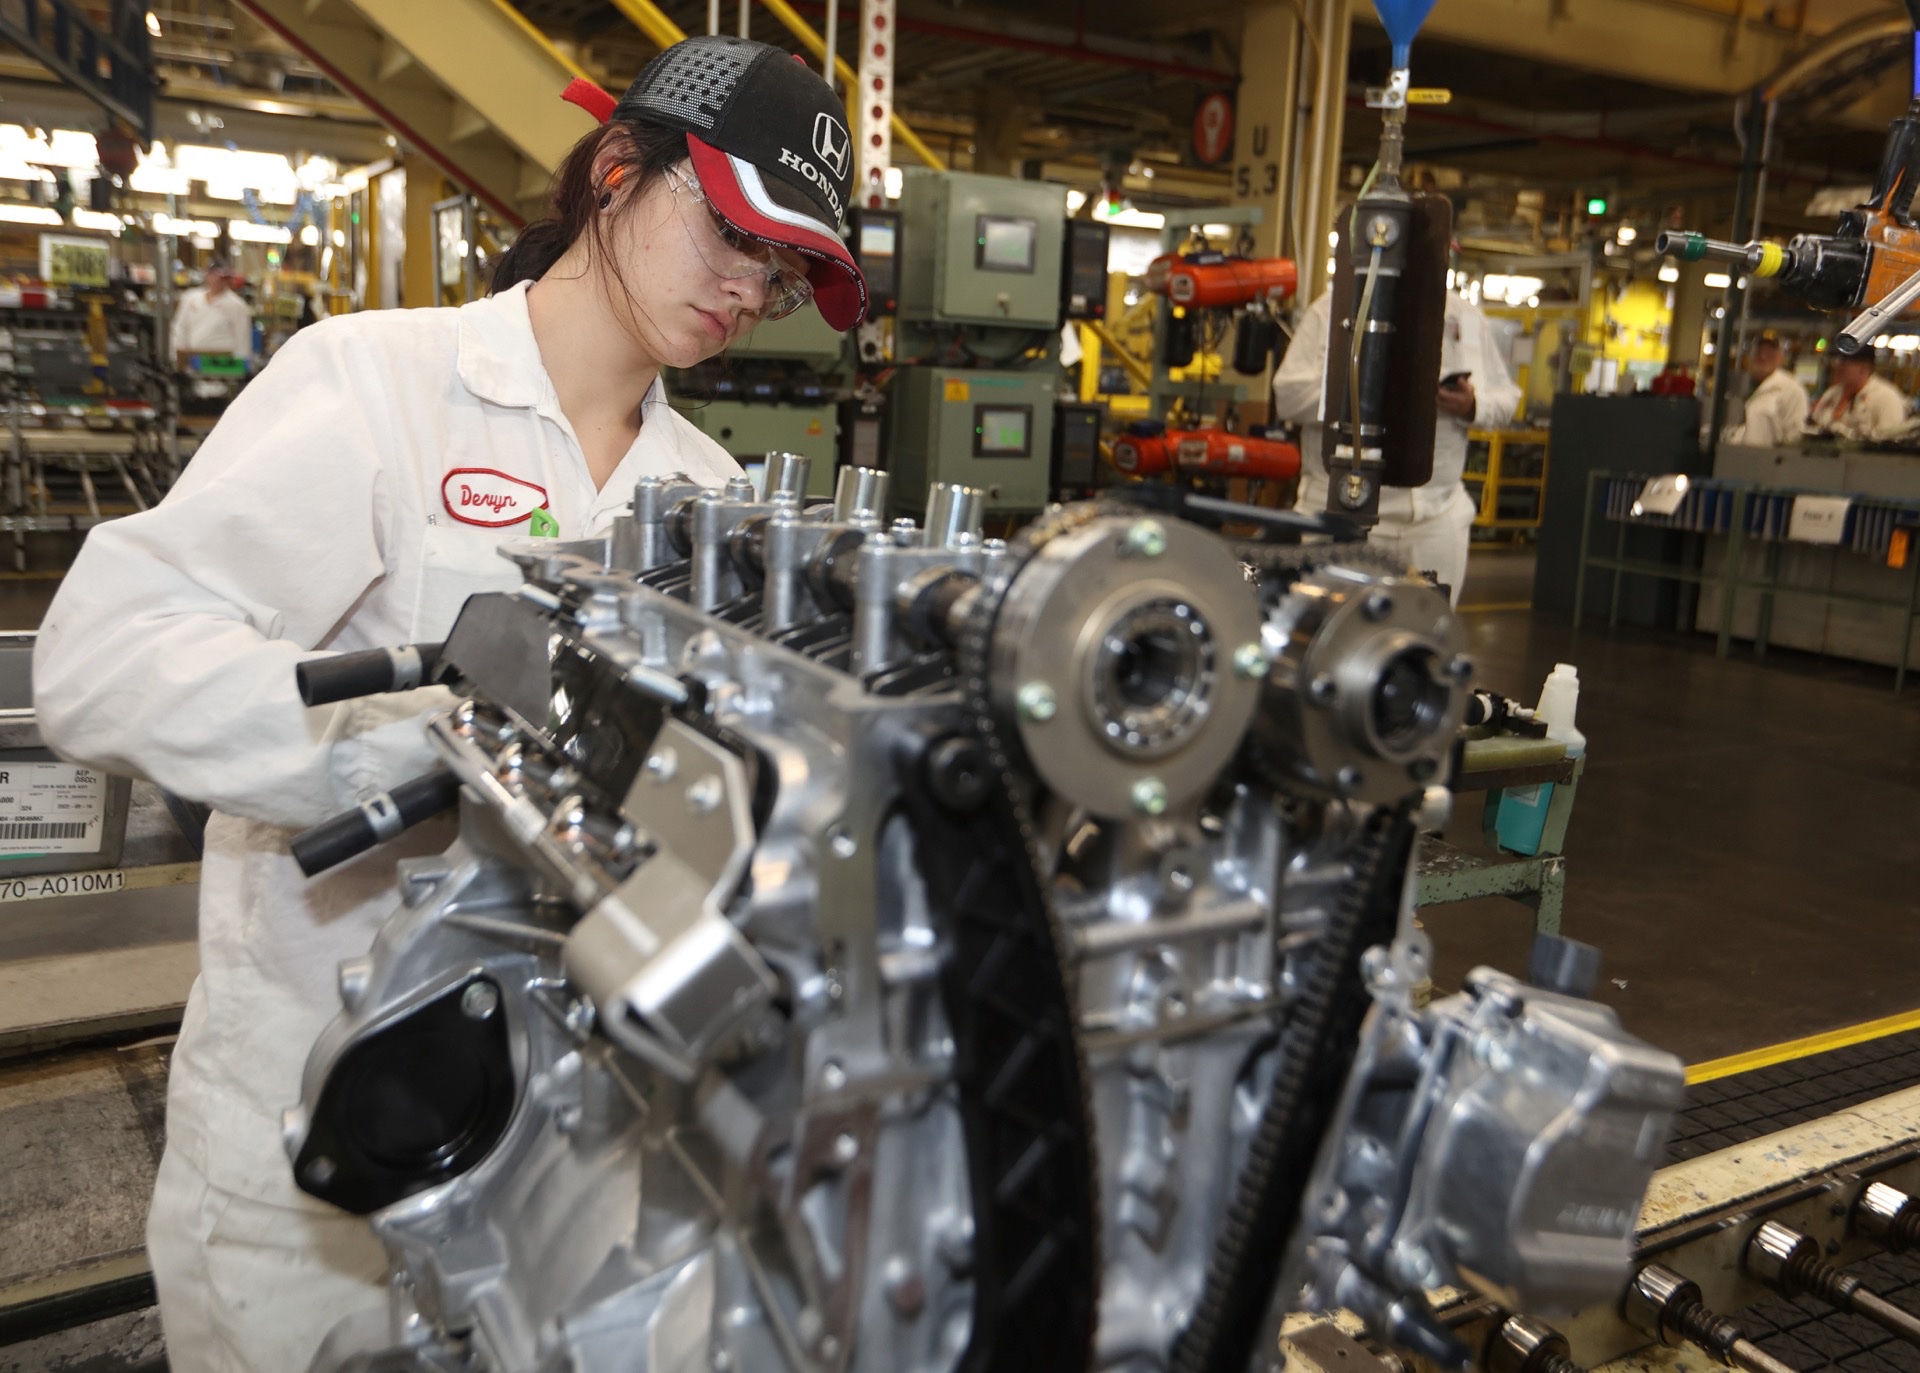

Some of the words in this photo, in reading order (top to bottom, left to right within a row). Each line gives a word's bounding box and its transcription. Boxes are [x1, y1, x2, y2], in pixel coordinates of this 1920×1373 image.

[778, 147, 844, 228] HONDA
[834, 258, 856, 276] HONDA
[0, 873, 123, 899] 70-A010M1
